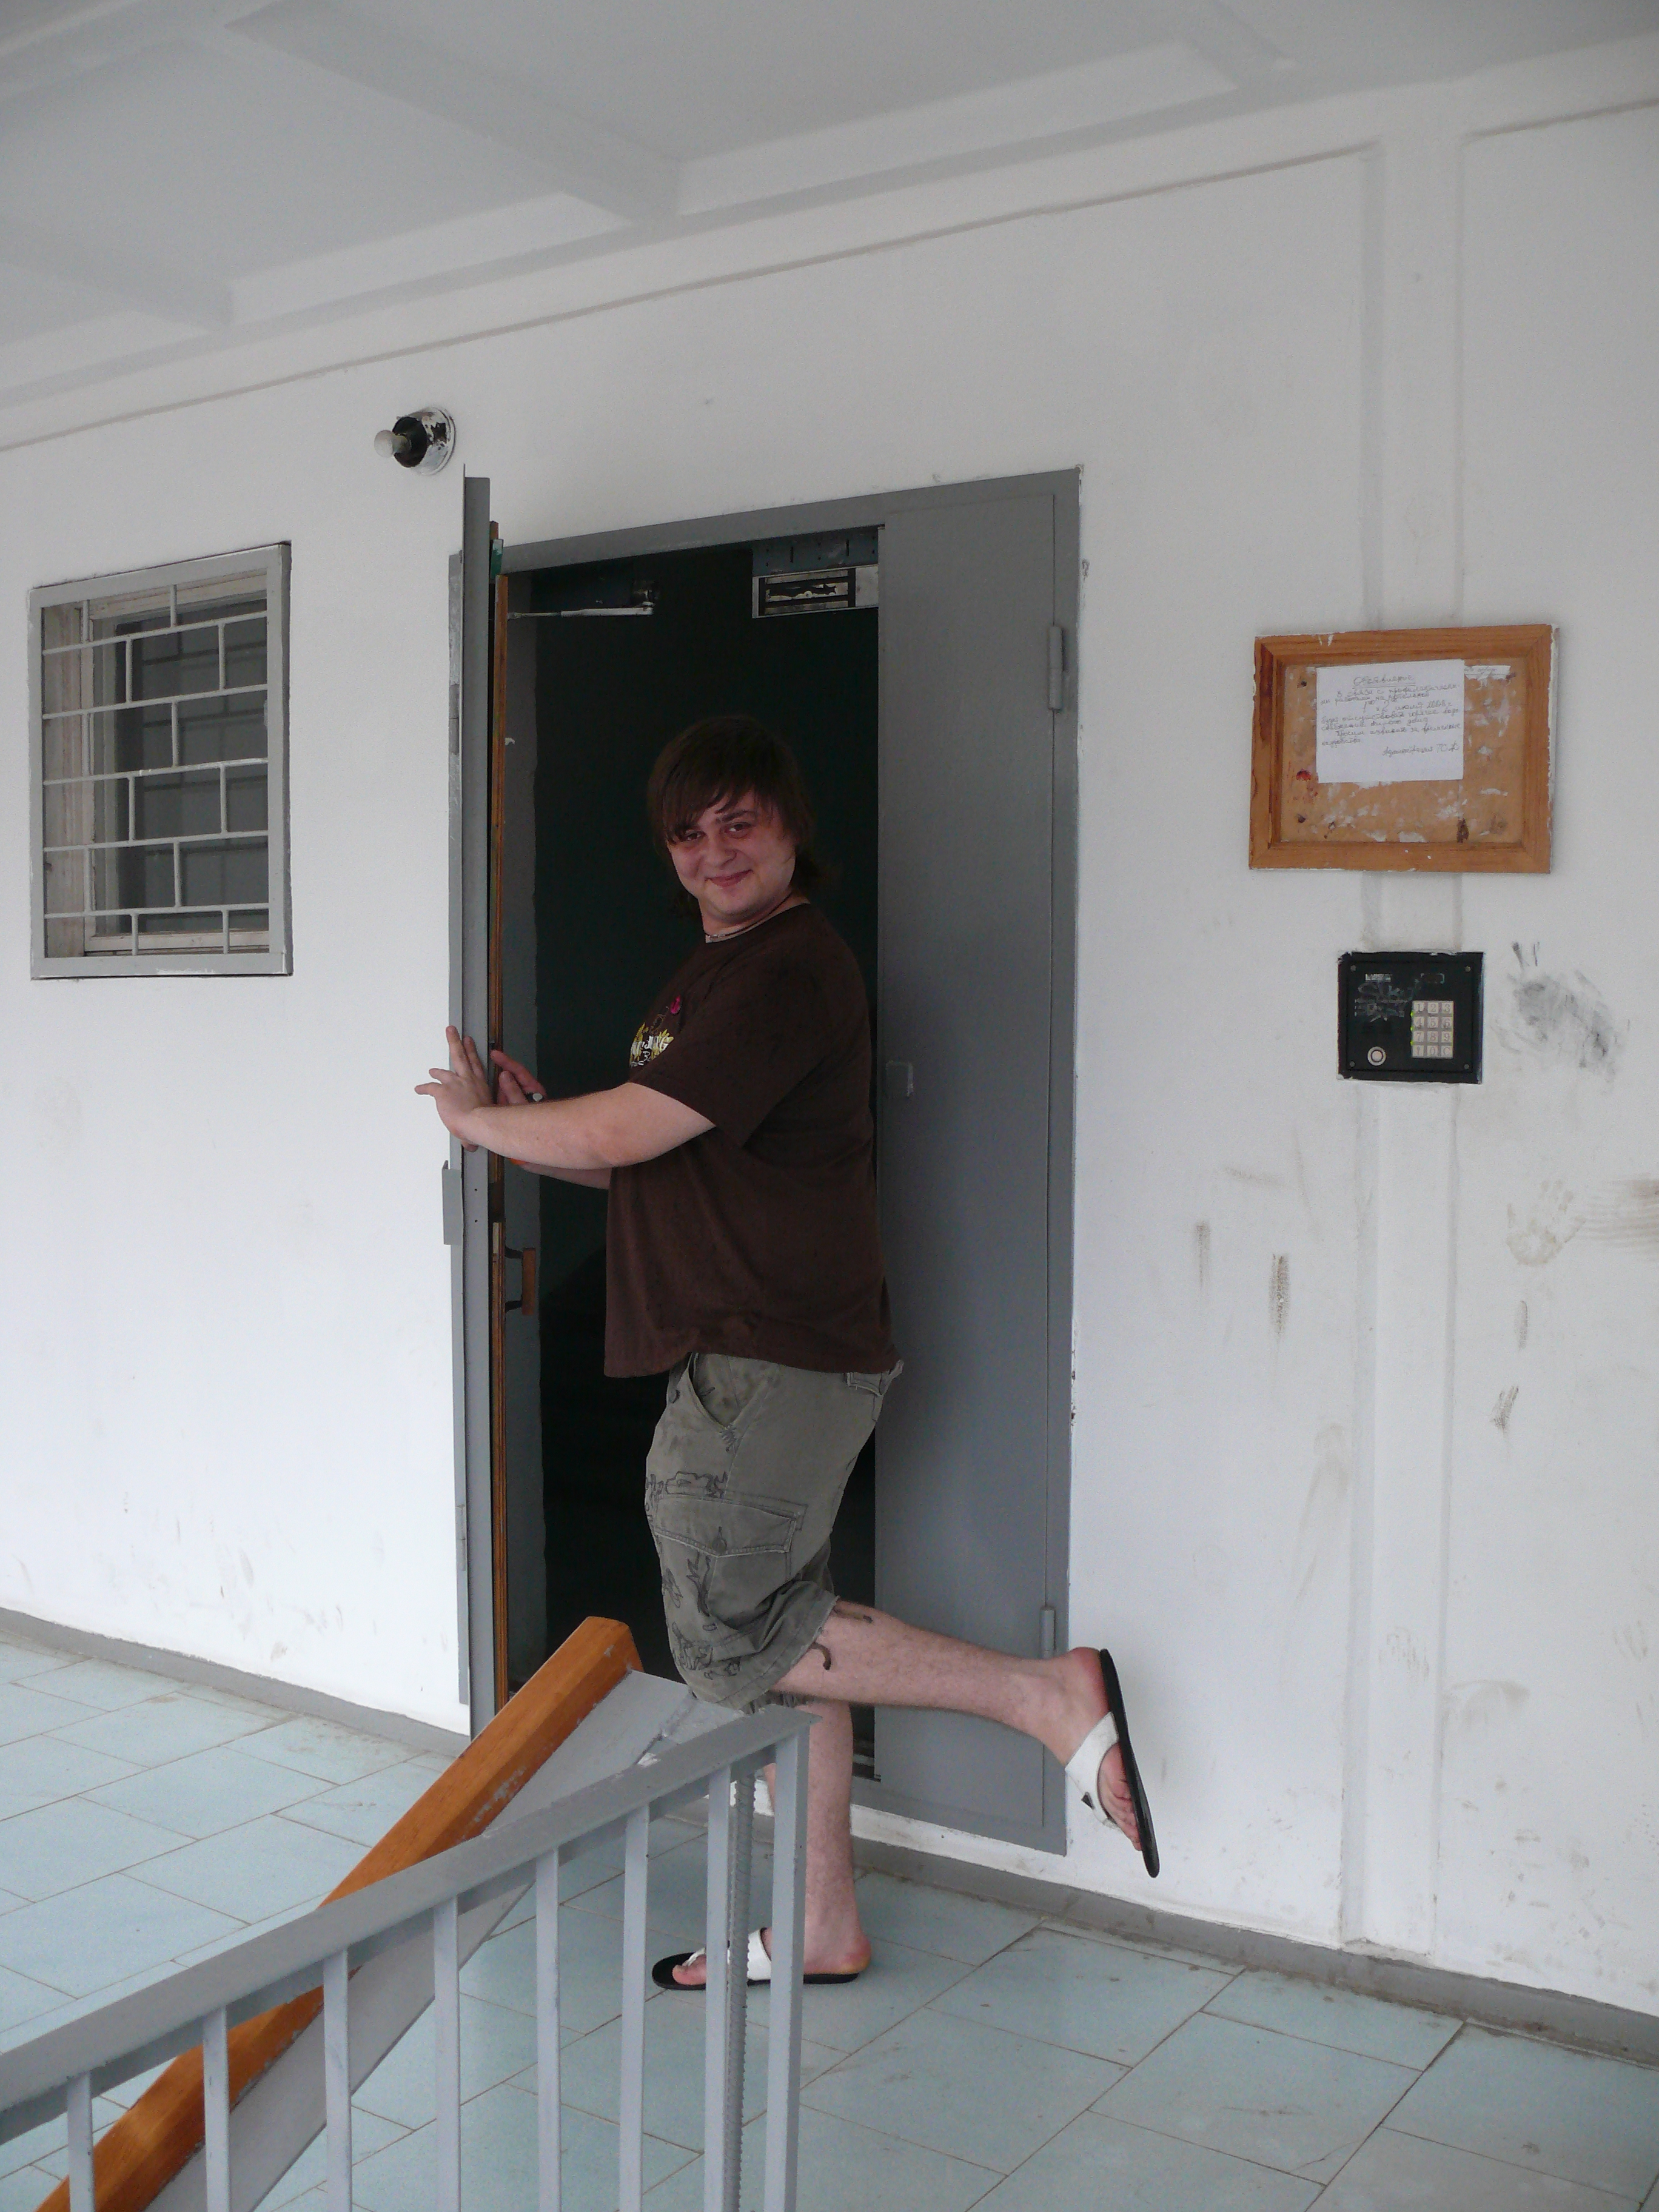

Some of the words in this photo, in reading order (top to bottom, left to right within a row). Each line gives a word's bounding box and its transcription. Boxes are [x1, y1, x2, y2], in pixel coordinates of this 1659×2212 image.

[1416, 1004, 1422, 1012] 1
[1430, 1004, 1436, 1012] 2
[1444, 1004, 1450, 1012] 3
[1416, 1018, 1422, 1027] 4
[1430, 1018, 1436, 1027] 5
[1444, 1018, 1450, 1027] 6
[1416, 1032, 1422, 1041] 7
[1430, 1032, 1436, 1041] 8
[1444, 1032, 1450, 1041] 9
[1430, 1047, 1436, 1055] 0
[1443, 1047, 1450, 1056] C
